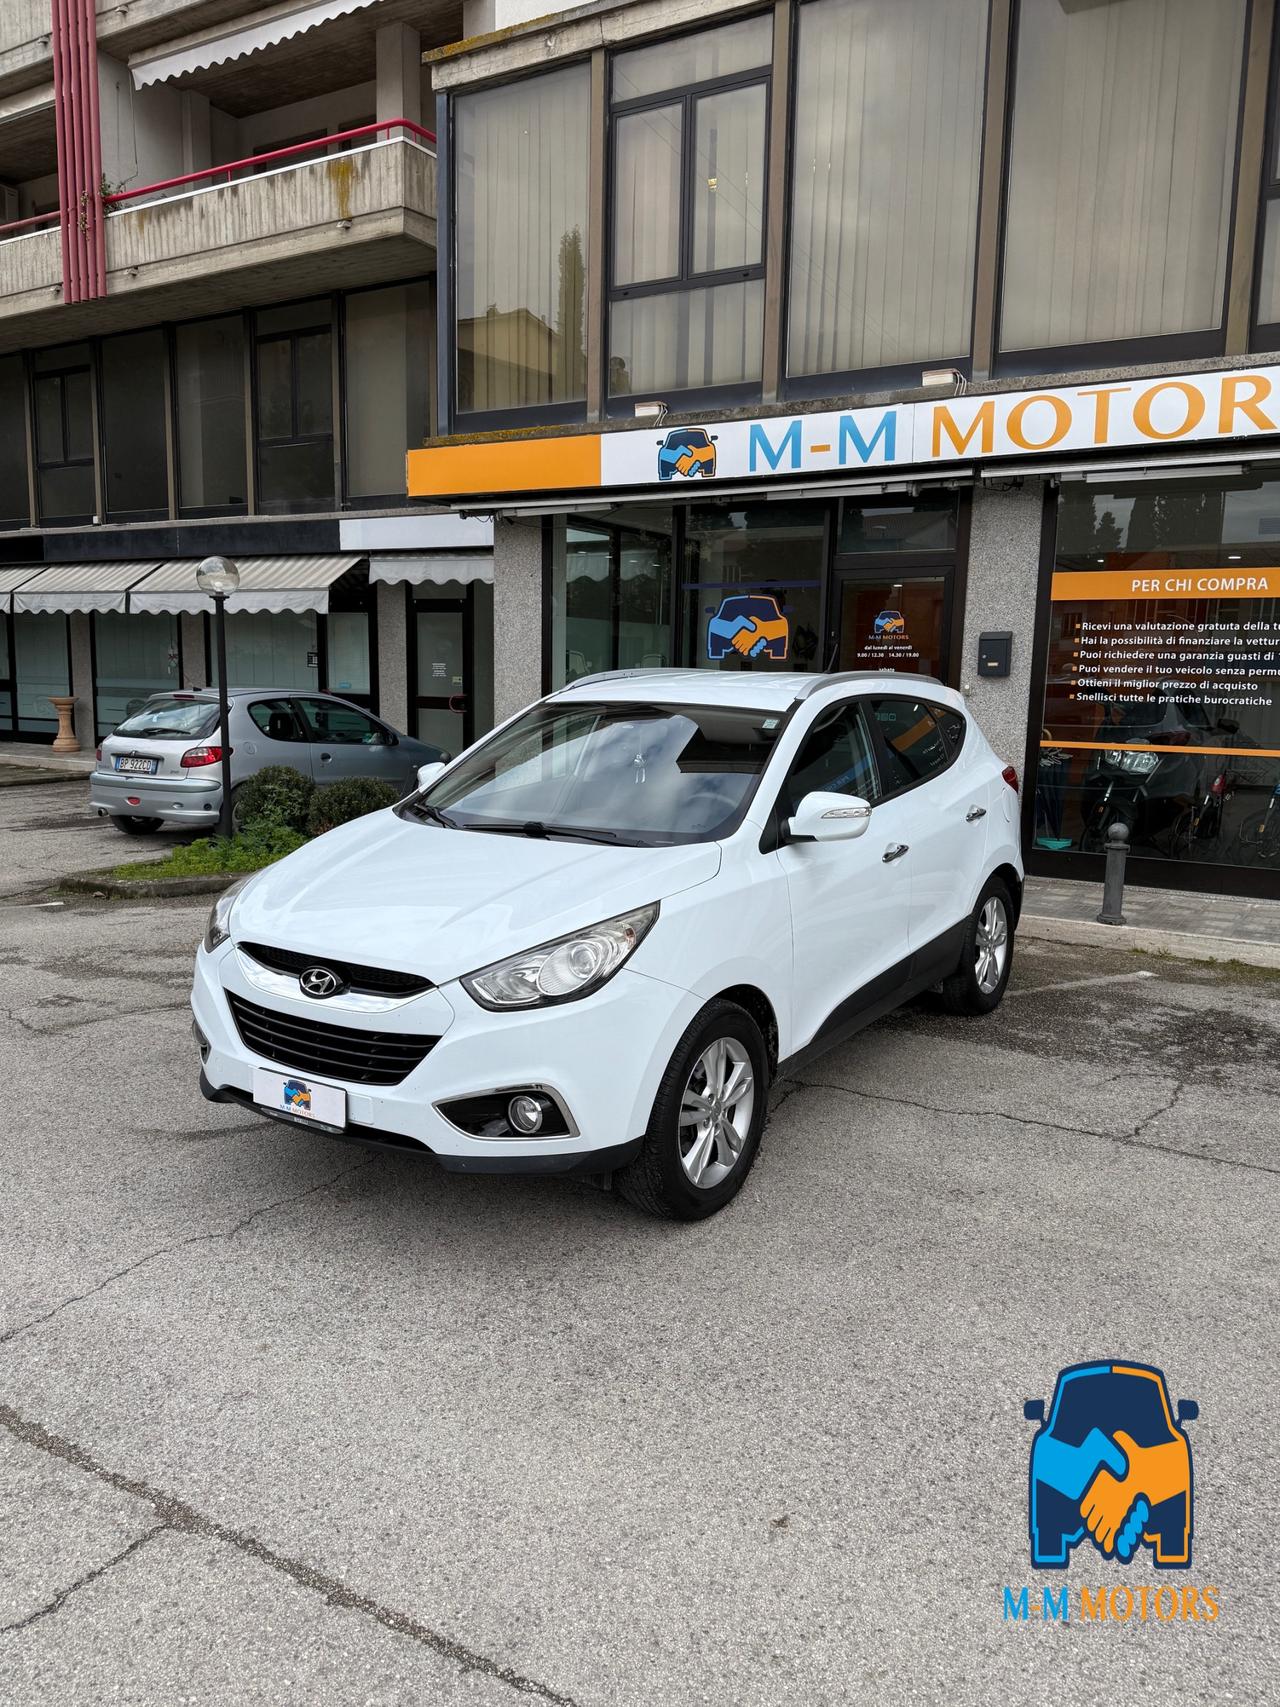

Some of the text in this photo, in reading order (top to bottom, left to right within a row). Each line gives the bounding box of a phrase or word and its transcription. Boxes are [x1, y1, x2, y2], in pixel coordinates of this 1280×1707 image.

[749, 411, 896, 472] M-M
[1131, 577, 1269, 592] PER CHI COMPRA
[1082, 622, 1111, 631] Ricevi
[1135, 622, 1194, 631] valutazione
[1243, 622, 1270, 631] della
[1081, 636, 1097, 645] Hai
[1100, 636, 1108, 645] la
[1111, 636, 1163, 646] possibilità
[1166, 636, 1176, 645] di
[1178, 636, 1230, 646] finanziare
[1234, 636, 1243, 646] la
[1080, 650, 1102, 659] Puoi
[1104, 650, 1154, 659] richiedere
[1180, 652, 1224, 662] garanzia
[1227, 652, 1260, 662] guasti
[1264, 652, 1274, 660] di
[1079, 665, 1100, 673] Puoi
[1103, 665, 1144, 674] vendere
[1146, 666, 1152, 674] il
[1176, 666, 1212, 675] veicolo
[1078, 679, 1258, 692] Ottieni il miglior prezzo di acquisto
[1076, 692, 1272, 706] Snellisci tutte le pratiche burocratiche
